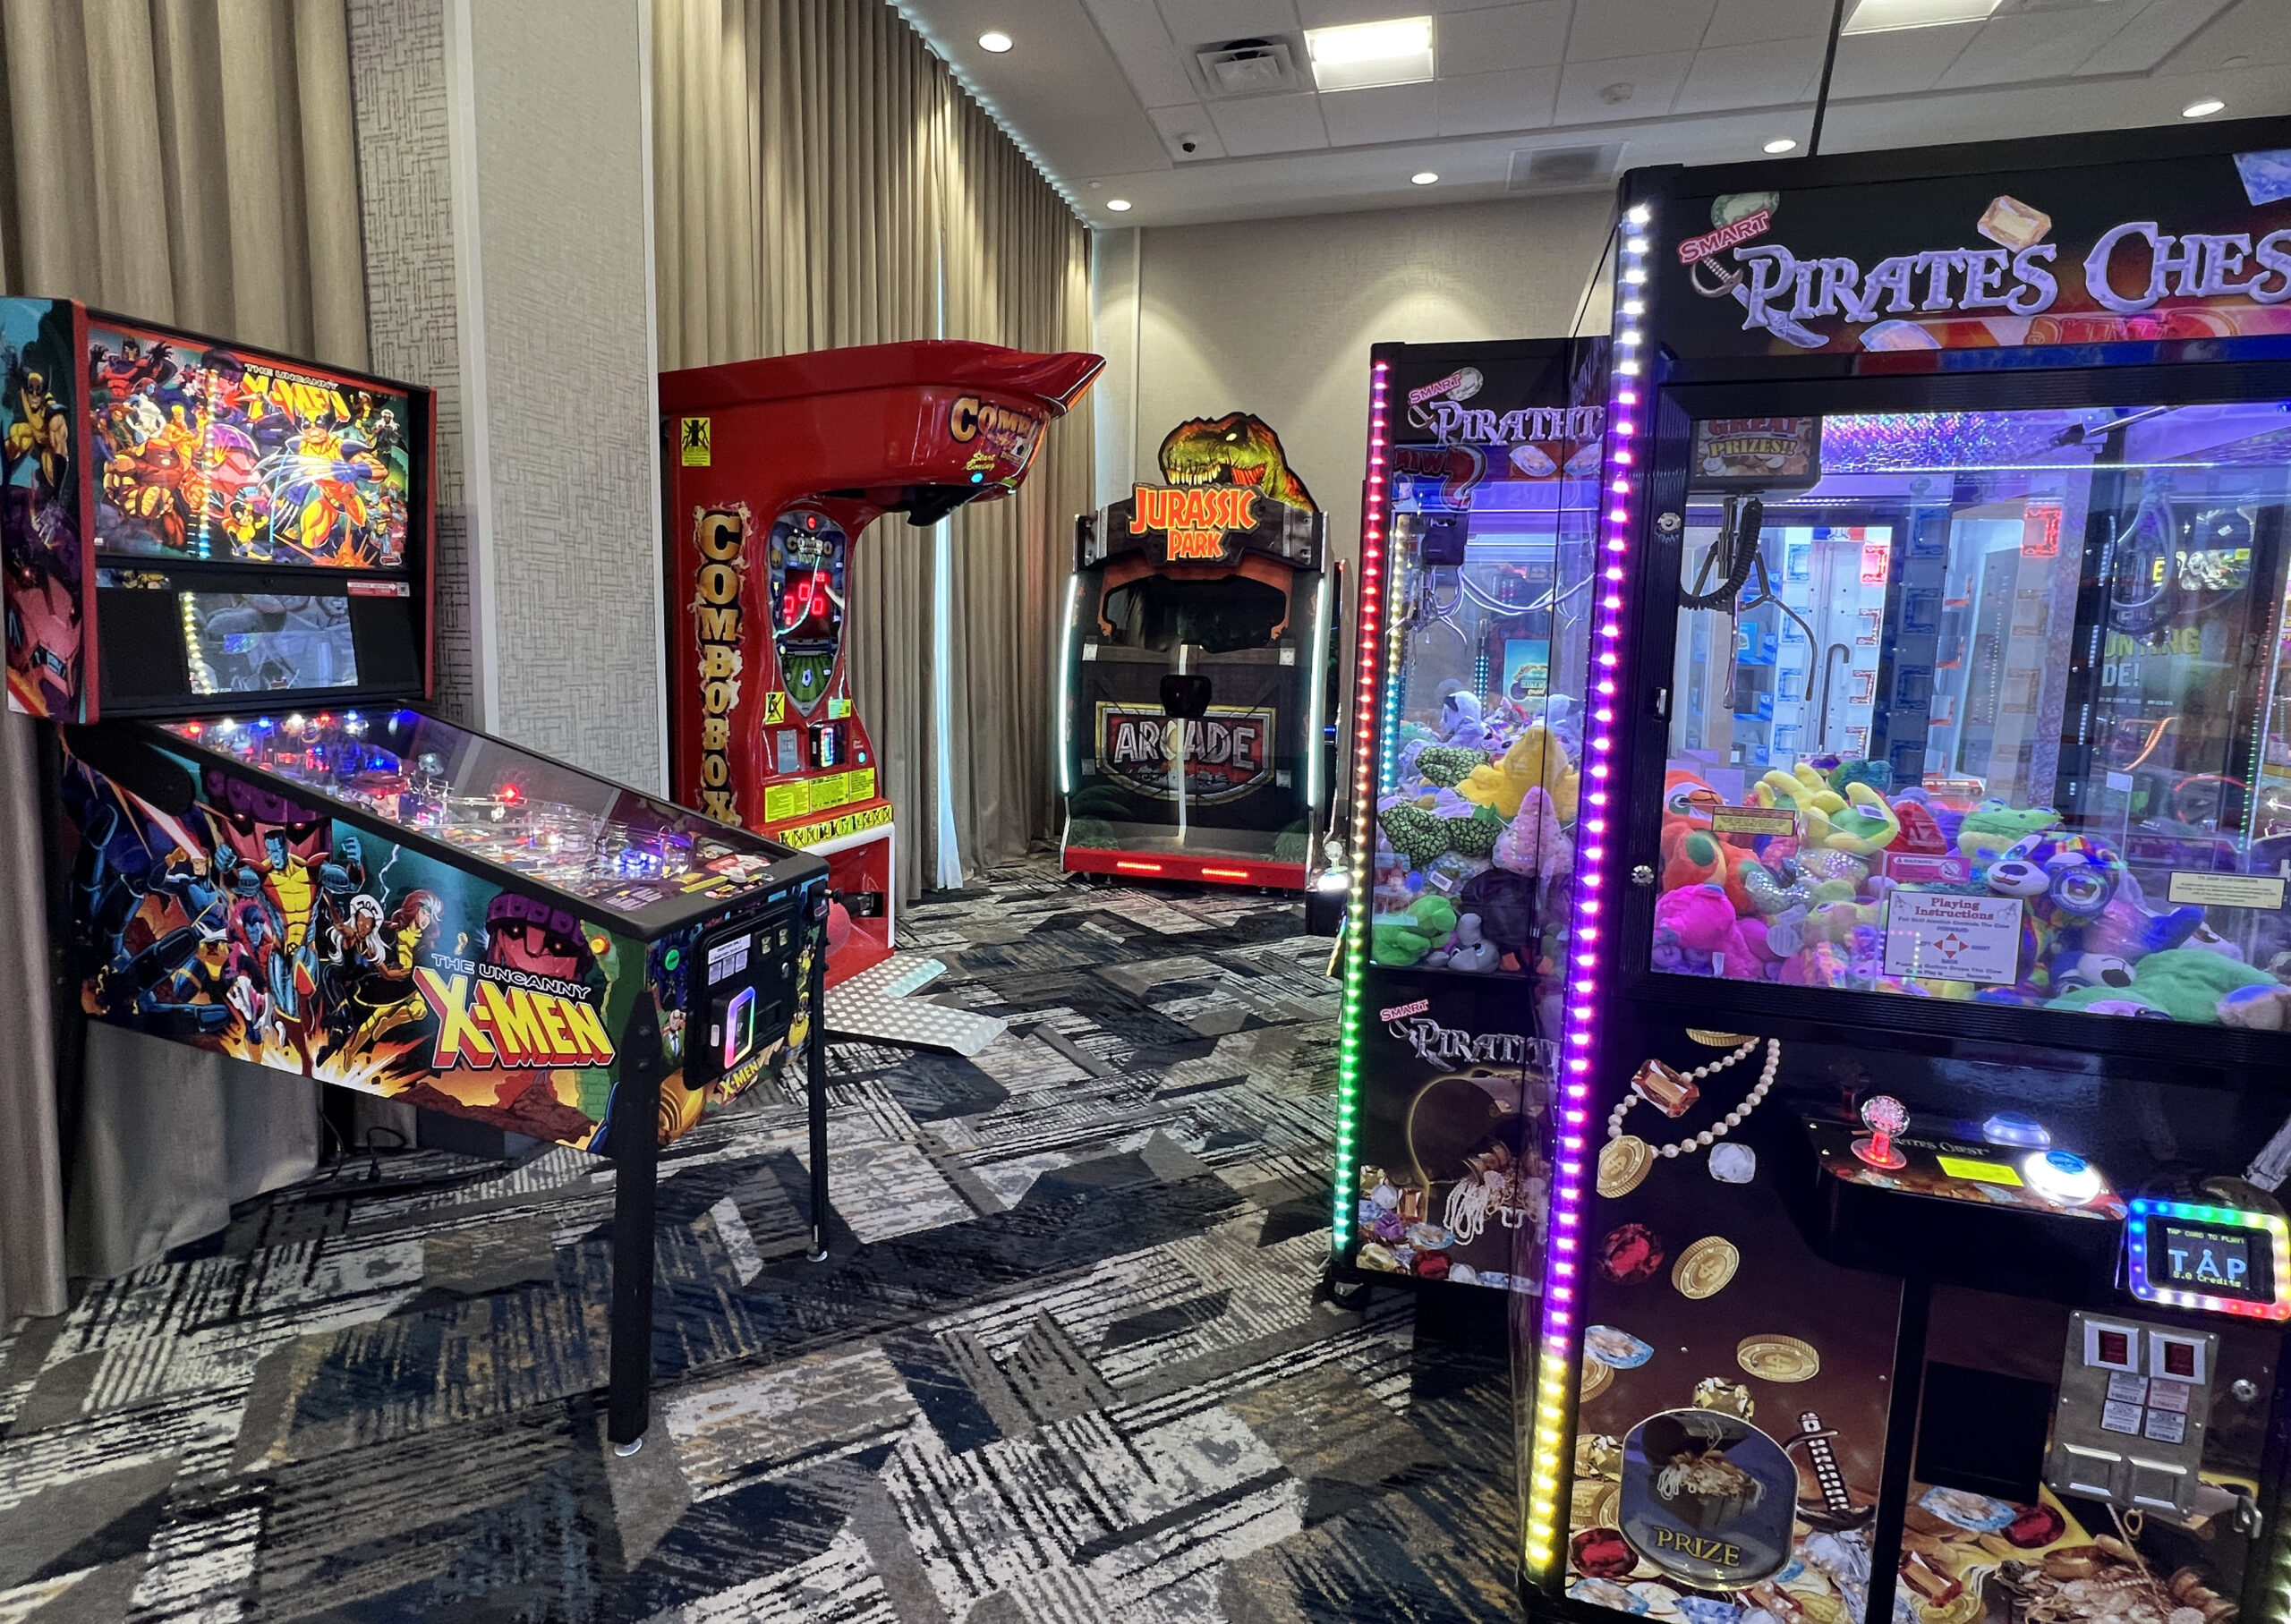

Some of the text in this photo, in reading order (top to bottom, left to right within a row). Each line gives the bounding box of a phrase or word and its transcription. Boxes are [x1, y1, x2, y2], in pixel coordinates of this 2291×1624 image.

[1678, 209, 1770, 264] SMART
[1733, 243, 2057, 331] PIRATES
[243, 362, 339, 390] THE UNCANNY
[1408, 372, 1462, 404] SMART
[239, 371, 352, 424] X-MEN
[950, 396, 1034, 442] COMB
[1708, 418, 1801, 436] GREAT
[1708, 438, 1798, 458] PRIZES!!
[1129, 486, 1257, 534] JURASSIC
[786, 535, 833, 556] COMBO
[1166, 528, 1224, 561] PARK
[1113, 720, 1256, 770] ARCADE
[1914, 906, 1994, 921] Instructions
[1931, 897, 1980, 911] Playing
[430, 953, 592, 1000] THE UNCANNY
[412, 965, 616, 1069] X-MEN
[1379, 999, 1429, 1022] SMART
[717, 1059, 760, 1103] X-MEN
[2167, 1227, 2182, 1235] TAP
[2208, 1233, 2219, 1241] TO
[2197, 1274, 2242, 1288] Credits
[1652, 1526, 1741, 1568] PRIZE
